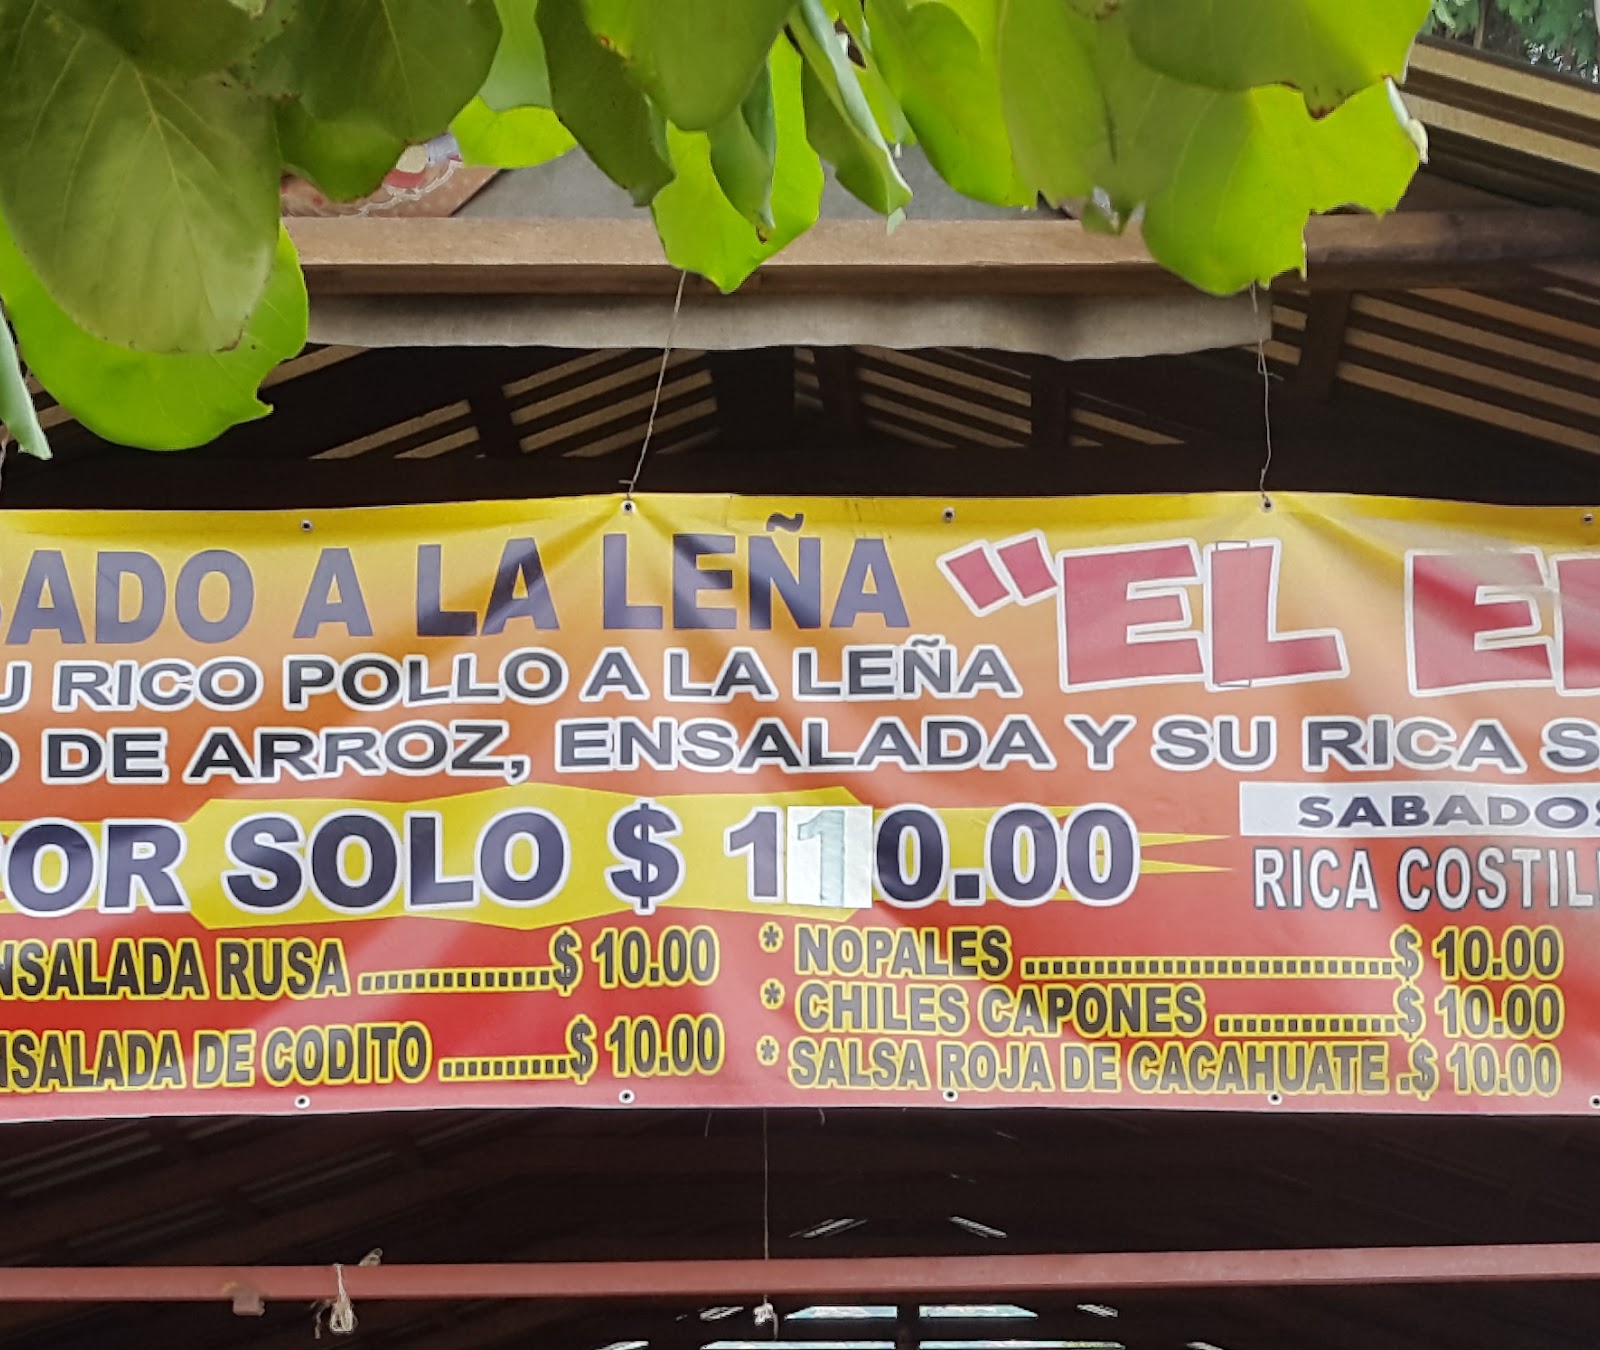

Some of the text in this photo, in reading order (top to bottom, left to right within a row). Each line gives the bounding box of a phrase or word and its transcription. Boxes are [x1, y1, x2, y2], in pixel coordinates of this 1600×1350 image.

[293, 547, 373, 638] A
[417, 537, 559, 637] LA
[602, 512, 910, 631] LEÑA
[54, 656, 263, 713] RICO
[284, 647, 569, 710] POLLO
[580, 647, 649, 701] A
[663, 646, 779, 702] LA
[793, 635, 1023, 701] LEÑA
[41, 727, 169, 784] DE
[183, 725, 530, 784] ARROZ,
[556, 717, 1057, 772] ENSALADA
[1064, 714, 1136, 770] Y
[1152, 715, 1277, 771] SU
[1302, 715, 1527, 773] RICA
[222, 808, 571, 908] SOLO
[606, 798, 685, 915] $
[1253, 846, 1380, 910] RICA
[217, 937, 350, 999] RUSA
[794, 924, 1013, 980] NOPALES
[796, 980, 971, 1035] CHILES
[978, 981, 1207, 1039] CAPONES
[194, 1028, 256, 1088] DE
[261, 1021, 432, 1084] CODITO
[787, 1037, 931, 1090] SALSA
[937, 1039, 1055, 1091] ROJA
[1061, 1042, 1122, 1093] DE
[1127, 1040, 1389, 1095] CACAHUATE
